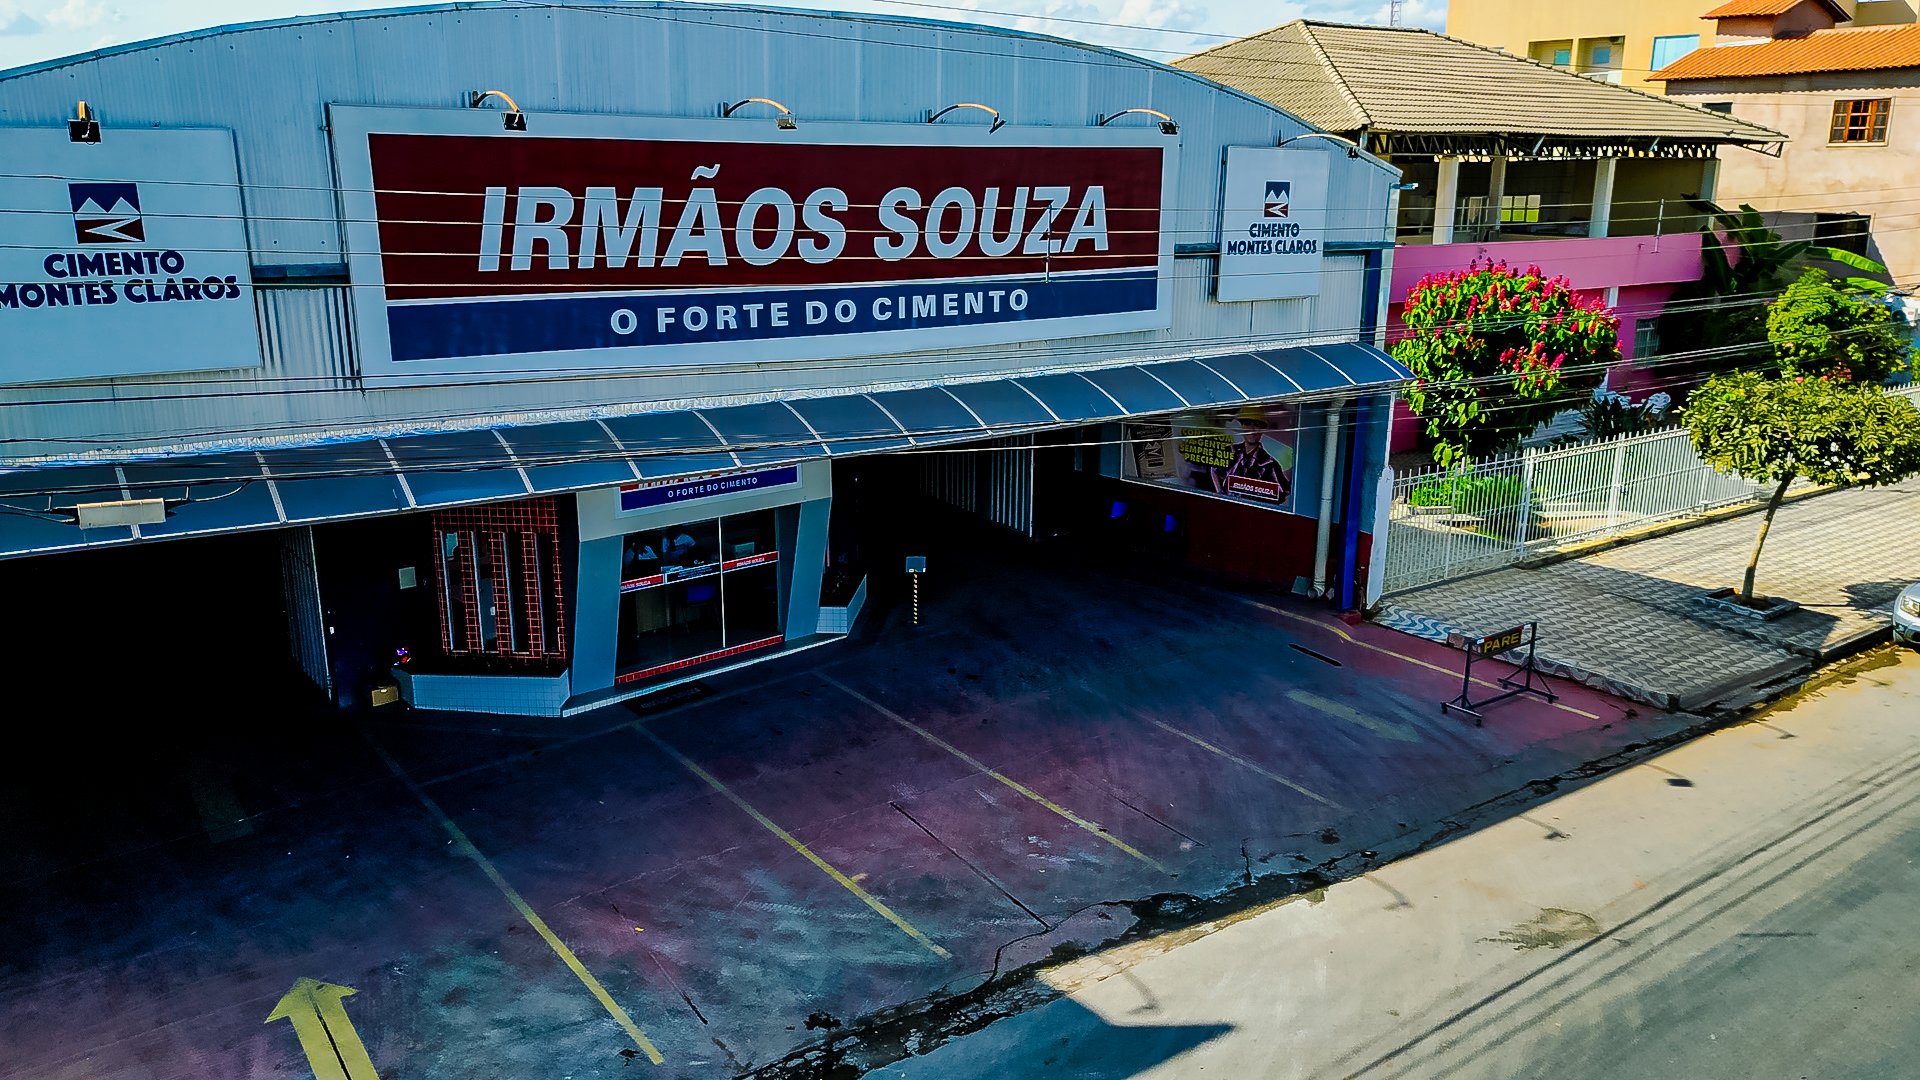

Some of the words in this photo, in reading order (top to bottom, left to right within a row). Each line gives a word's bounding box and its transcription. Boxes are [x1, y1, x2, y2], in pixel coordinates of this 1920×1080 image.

[478, 163, 848, 271] IRMÃOS
[874, 185, 1109, 261] SOUZA
[1249, 222, 1300, 238] CIMENTO
[1227, 240, 1272, 255] MONTES
[1275, 239, 1317, 254] CLAROS
[43, 250, 185, 278] CIMENTO
[0, 280, 118, 309] MONTES
[124, 276, 241, 304] CLAROS
[610, 308, 638, 335] O
[657, 302, 789, 333] FORTE
[805, 299, 857, 325] DO
[872, 289, 1029, 321] CIMENTO
[1179, 443, 1214, 457] SEMPRE
[1216, 449, 1235, 461] QUE
[1197, 439, 1226, 450] GENTE
[1184, 453, 1229, 468] PRECISAR!
[667, 490, 674, 498] O
[676, 485, 705, 497] FORTE
[706, 483, 719, 492] DO
[720, 477, 758, 489] CIMENTO
[1484, 632, 1520, 653] PARE
